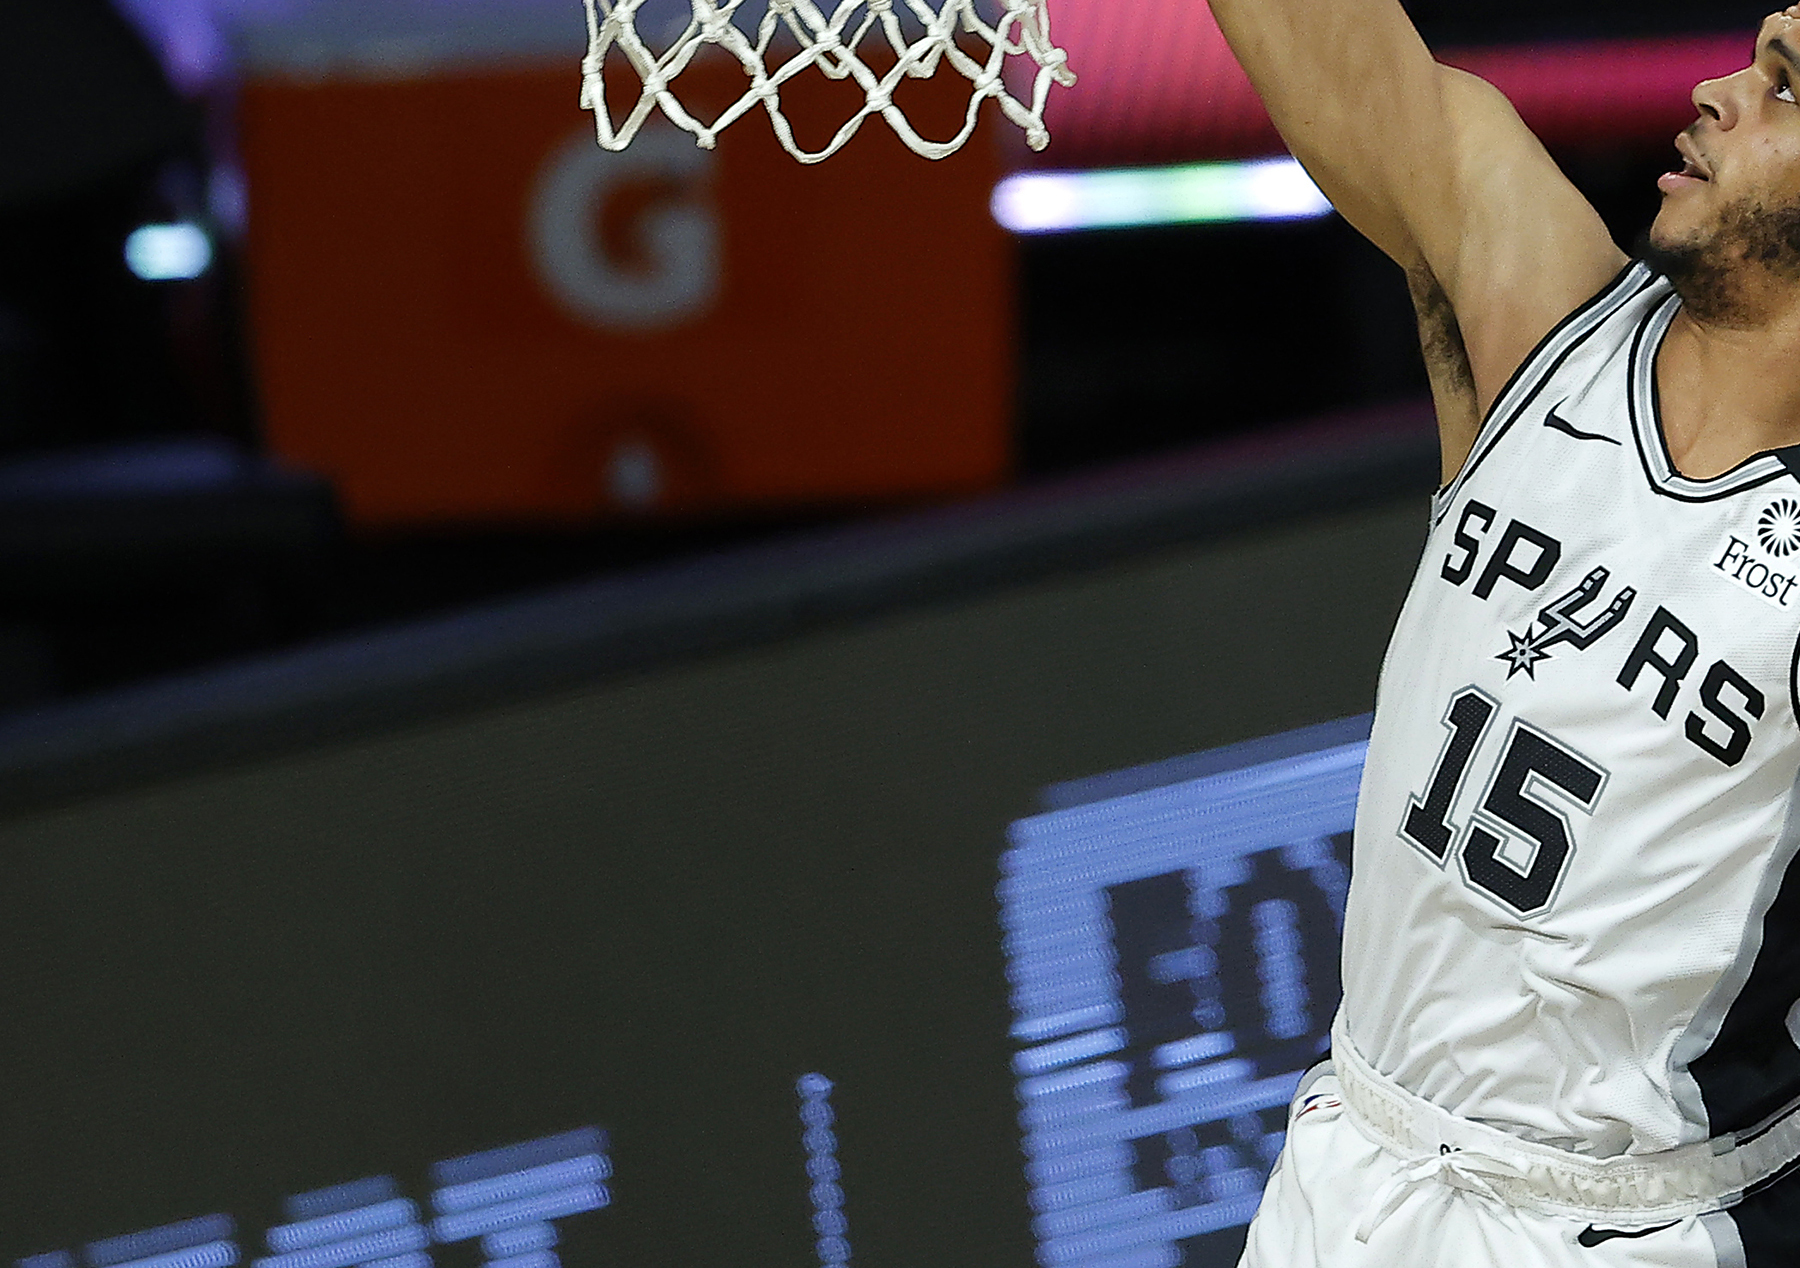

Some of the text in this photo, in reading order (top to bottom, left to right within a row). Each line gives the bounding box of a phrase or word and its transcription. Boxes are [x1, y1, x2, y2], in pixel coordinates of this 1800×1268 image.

[526, 122, 722, 332] G
[1713, 535, 1800, 607] Frost
[1397, 683, 1611, 921] 15
